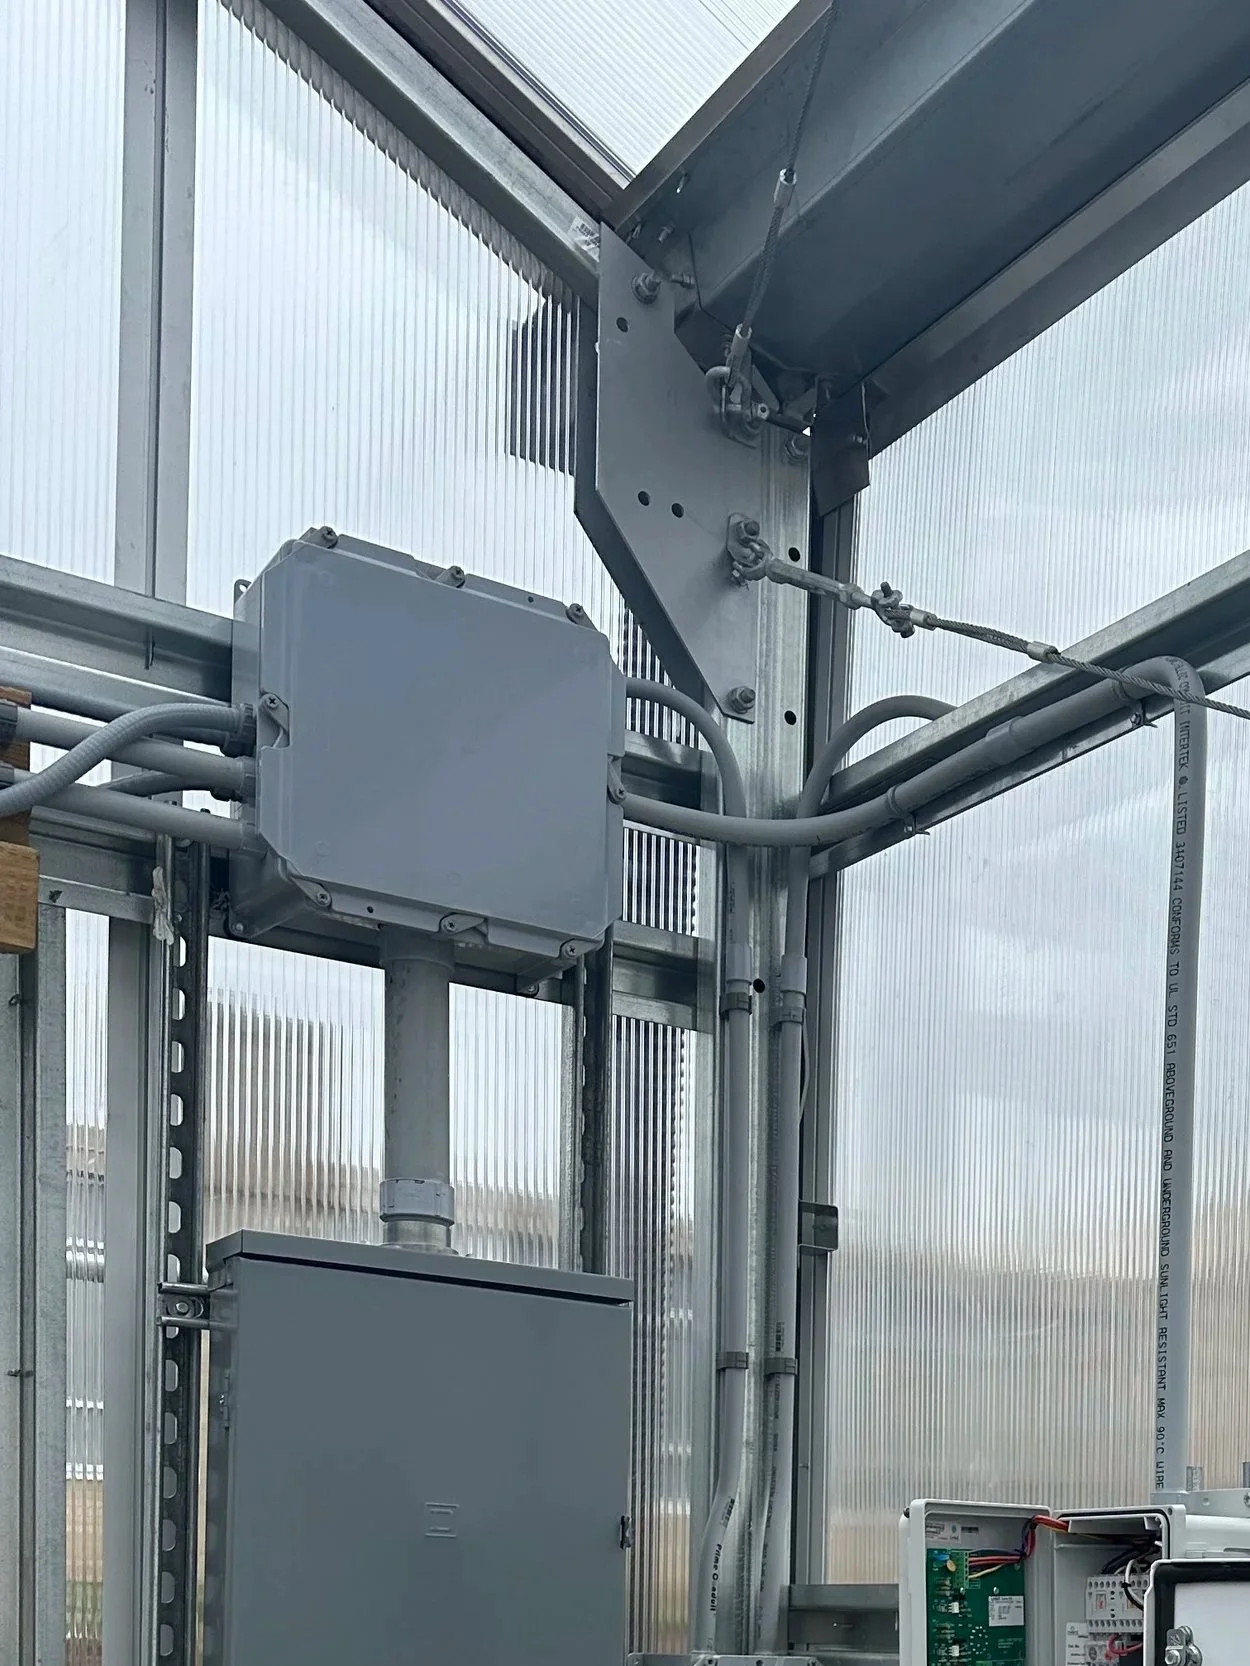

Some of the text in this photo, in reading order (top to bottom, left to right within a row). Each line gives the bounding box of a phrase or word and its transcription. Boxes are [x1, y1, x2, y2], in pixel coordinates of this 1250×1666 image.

[1178, 720, 1191, 771] INTERTEK
[1176, 791, 1188, 835] LISTED
[1169, 897, 1182, 955] CONFORMS
[1169, 961, 1180, 976] TO
[1168, 983, 1178, 998] UL
[1167, 1004, 1178, 1027] STD
[1166, 1034, 1176, 1055] 651
[1163, 1062, 1175, 1143] ABOVEGROUND
[1162, 1149, 1173, 1171] AND
[1160, 1178, 1172, 1257] UNDERGROUND
[1159, 1263, 1169, 1320] SUNLIGHT
[1157, 1327, 1168, 1390] RESISTANT
[1156, 1397, 1166, 1418] MAX
[1155, 1461, 1164, 1489] WIRE
